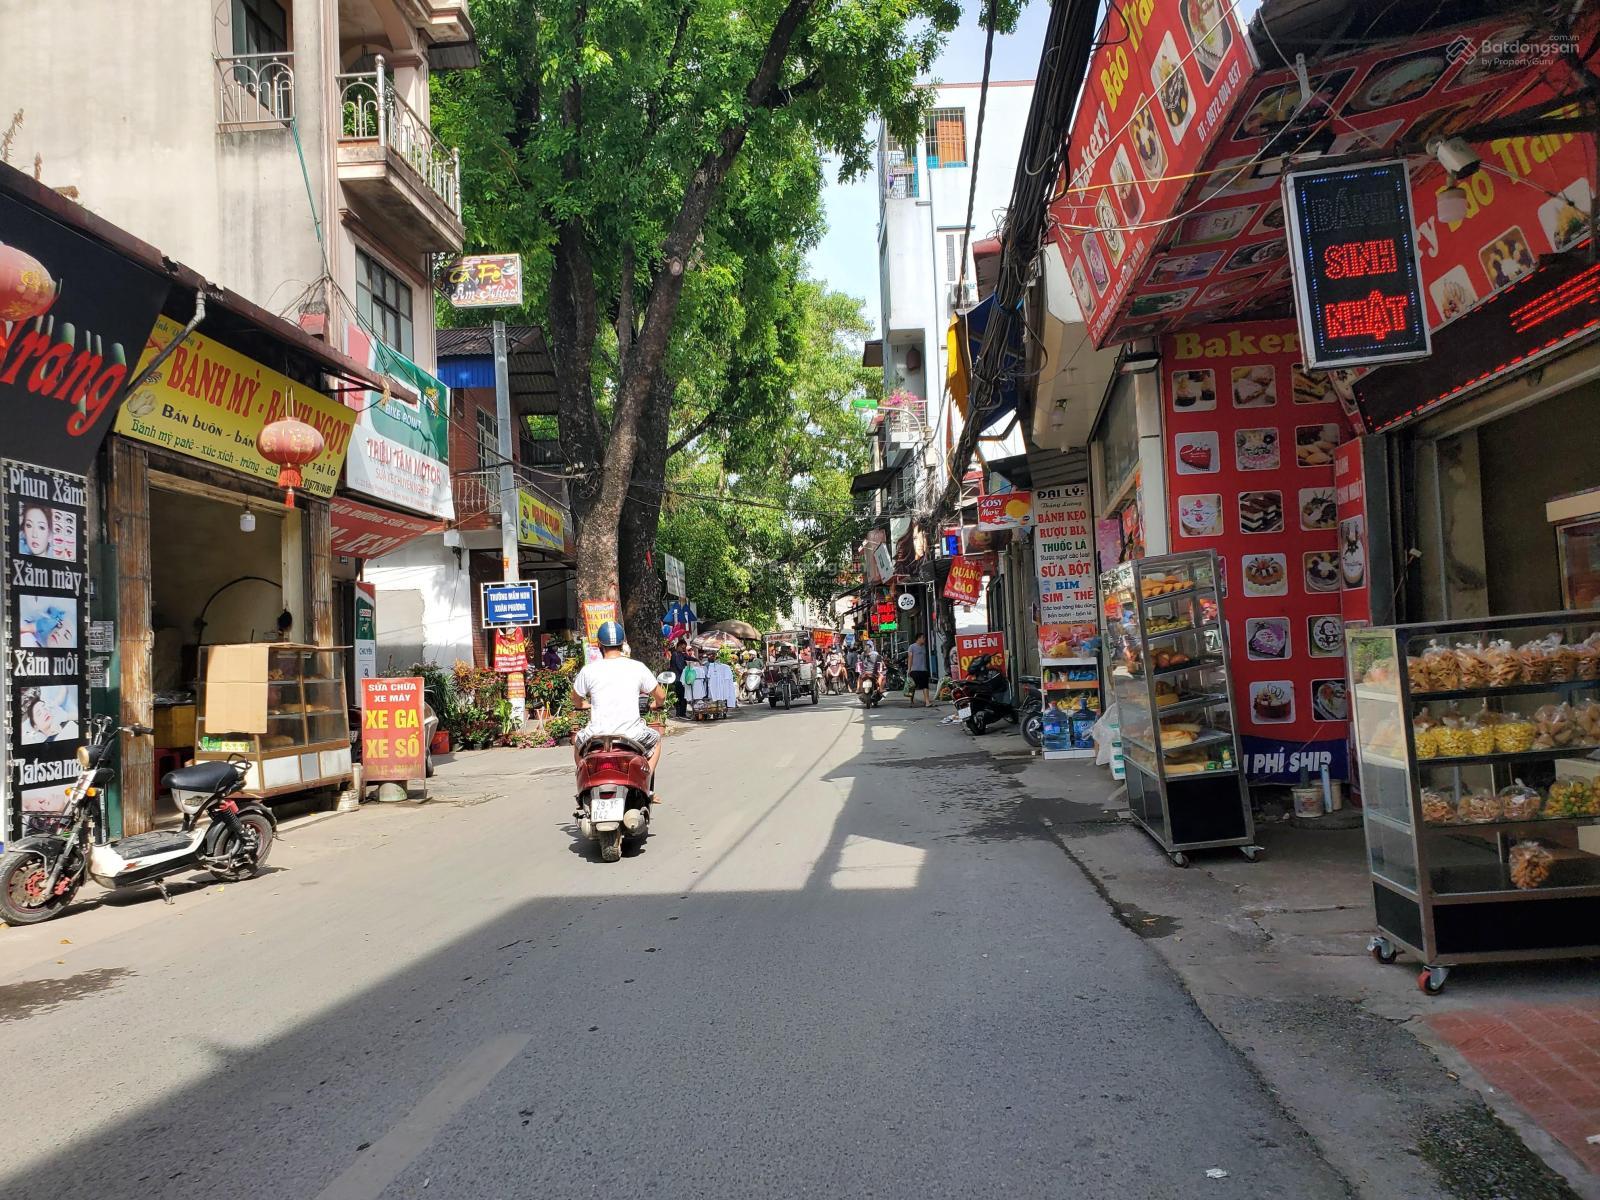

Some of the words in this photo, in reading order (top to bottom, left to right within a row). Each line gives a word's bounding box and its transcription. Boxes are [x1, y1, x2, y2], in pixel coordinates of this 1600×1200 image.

[167, 341, 231, 407] BÁNH
[414, 458, 441, 485] MOTOR
[9, 467, 49, 500] Phun
[52, 475, 86, 507] Xăm
[1037, 510, 1065, 524] BÁNH
[1067, 510, 1087, 523] KẸO
[1040, 526, 1068, 539] RƯỢU
[1042, 538, 1072, 553] THUỐC
[1075, 538, 1087, 550] LÁ
[12, 559, 49, 588] Xăm
[52, 565, 82, 597] mày
[1041, 561, 1066, 577] SỮA
[1068, 560, 1091, 577] BỘT
[1042, 592, 1064, 603] SIM
[963, 634, 998, 649] BIỂN
[14, 649, 50, 677] Xăm
[53, 651, 79, 676] môi
[368, 681, 388, 692] SỬA
[391, 681, 417, 691] CHỮA
[374, 695, 387, 703] XE
[365, 709, 389, 729] XE
[395, 708, 419, 728] GA
[365, 738, 389, 758] XE
[395, 730, 420, 758] SỐ
[1253, 746, 1285, 773] PHÍ
[1289, 750, 1332, 772] SHIP
